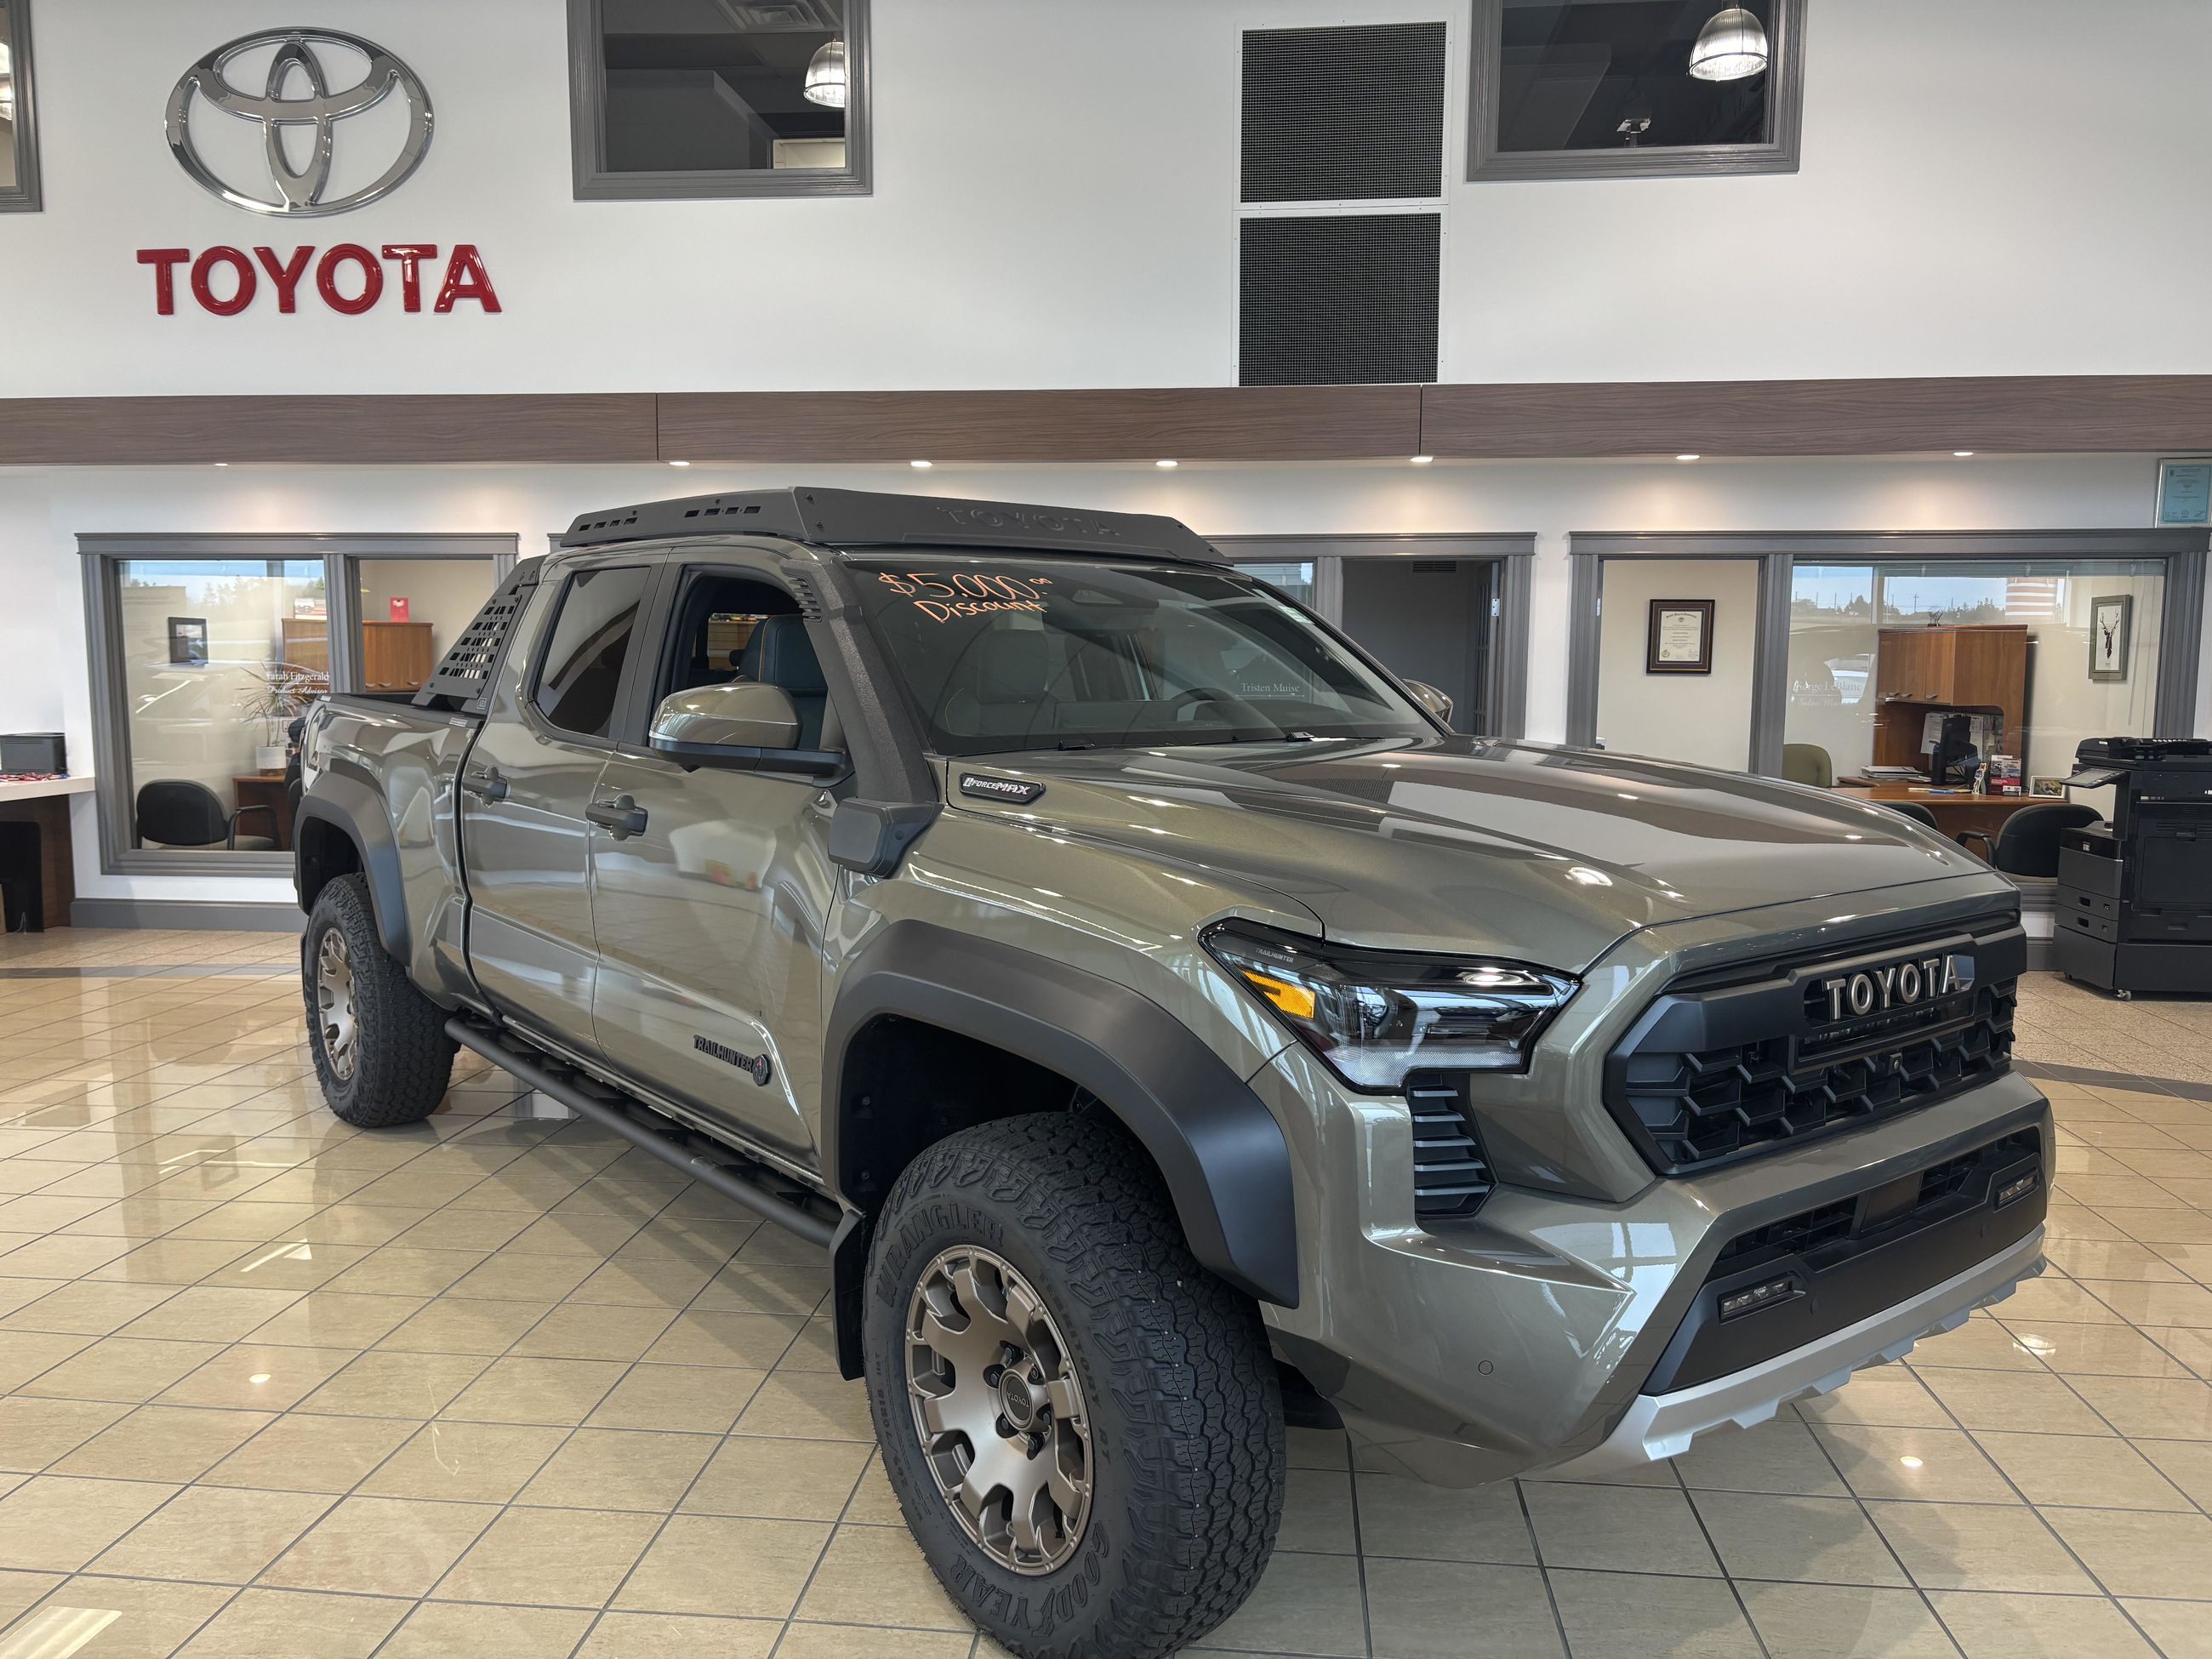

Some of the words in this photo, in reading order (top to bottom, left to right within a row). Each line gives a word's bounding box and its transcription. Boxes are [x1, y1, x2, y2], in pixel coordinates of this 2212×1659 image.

[136, 243, 502, 316] TOYOTA
[936, 506, 1121, 536] TOYOTA
[913, 600, 1047, 624] Discount
[290, 670, 329, 683] Fitzgerald
[1240, 683, 1270, 693] Tristen
[1274, 683, 1300, 693] Muise
[1256, 947, 1294, 963] TRAILHUNTER
[1822, 954, 1960, 1022] TOYOTA
[693, 1034, 755, 1074] TRAILHUNTER
[875, 1202, 1004, 1308] WRANGLER
[1007, 1391, 1030, 1408] TOYOTA
[950, 1520, 1110, 1638] GOODYEAR
